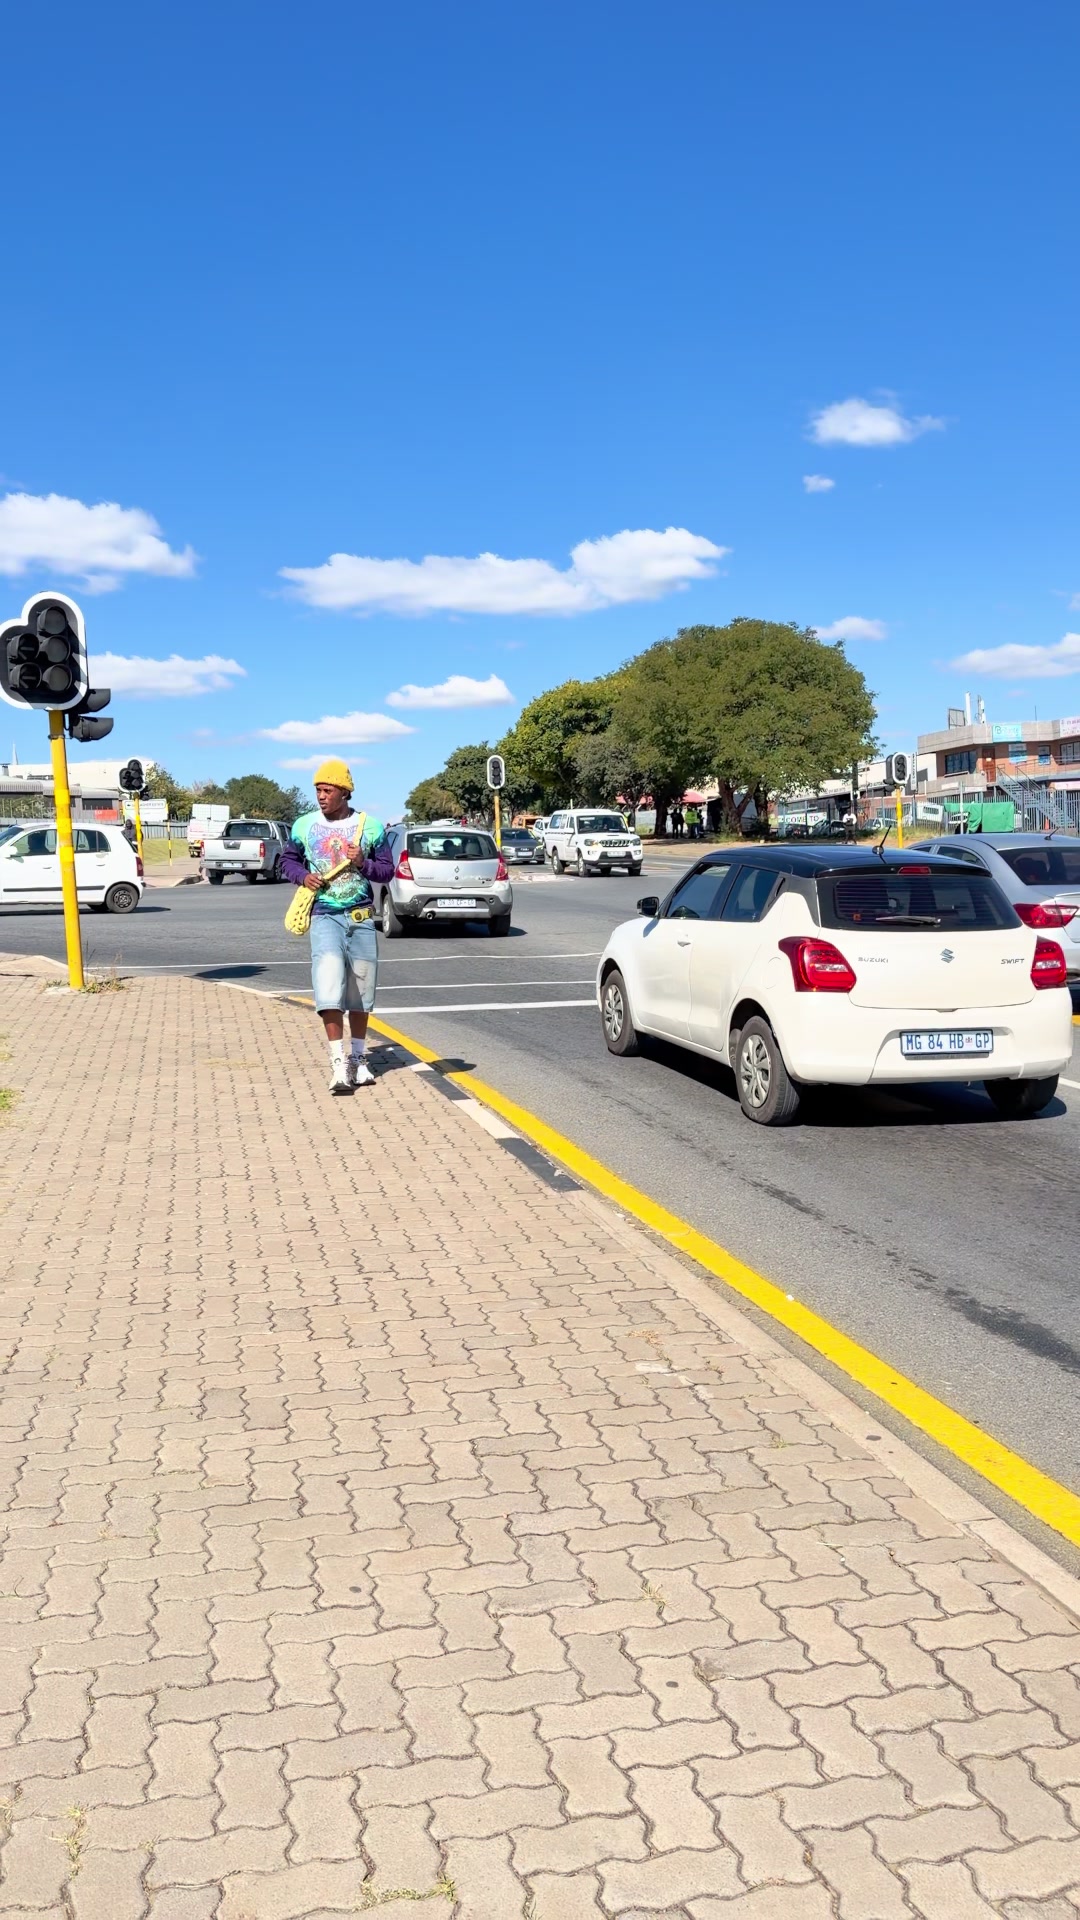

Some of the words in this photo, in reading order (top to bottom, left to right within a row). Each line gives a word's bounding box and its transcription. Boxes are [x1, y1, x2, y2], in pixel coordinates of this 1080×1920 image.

[906, 1034, 922, 1050] MG
[928, 1034, 943, 1049] 84
[949, 1033, 964, 1049] HB
[975, 1032, 989, 1048] GP
